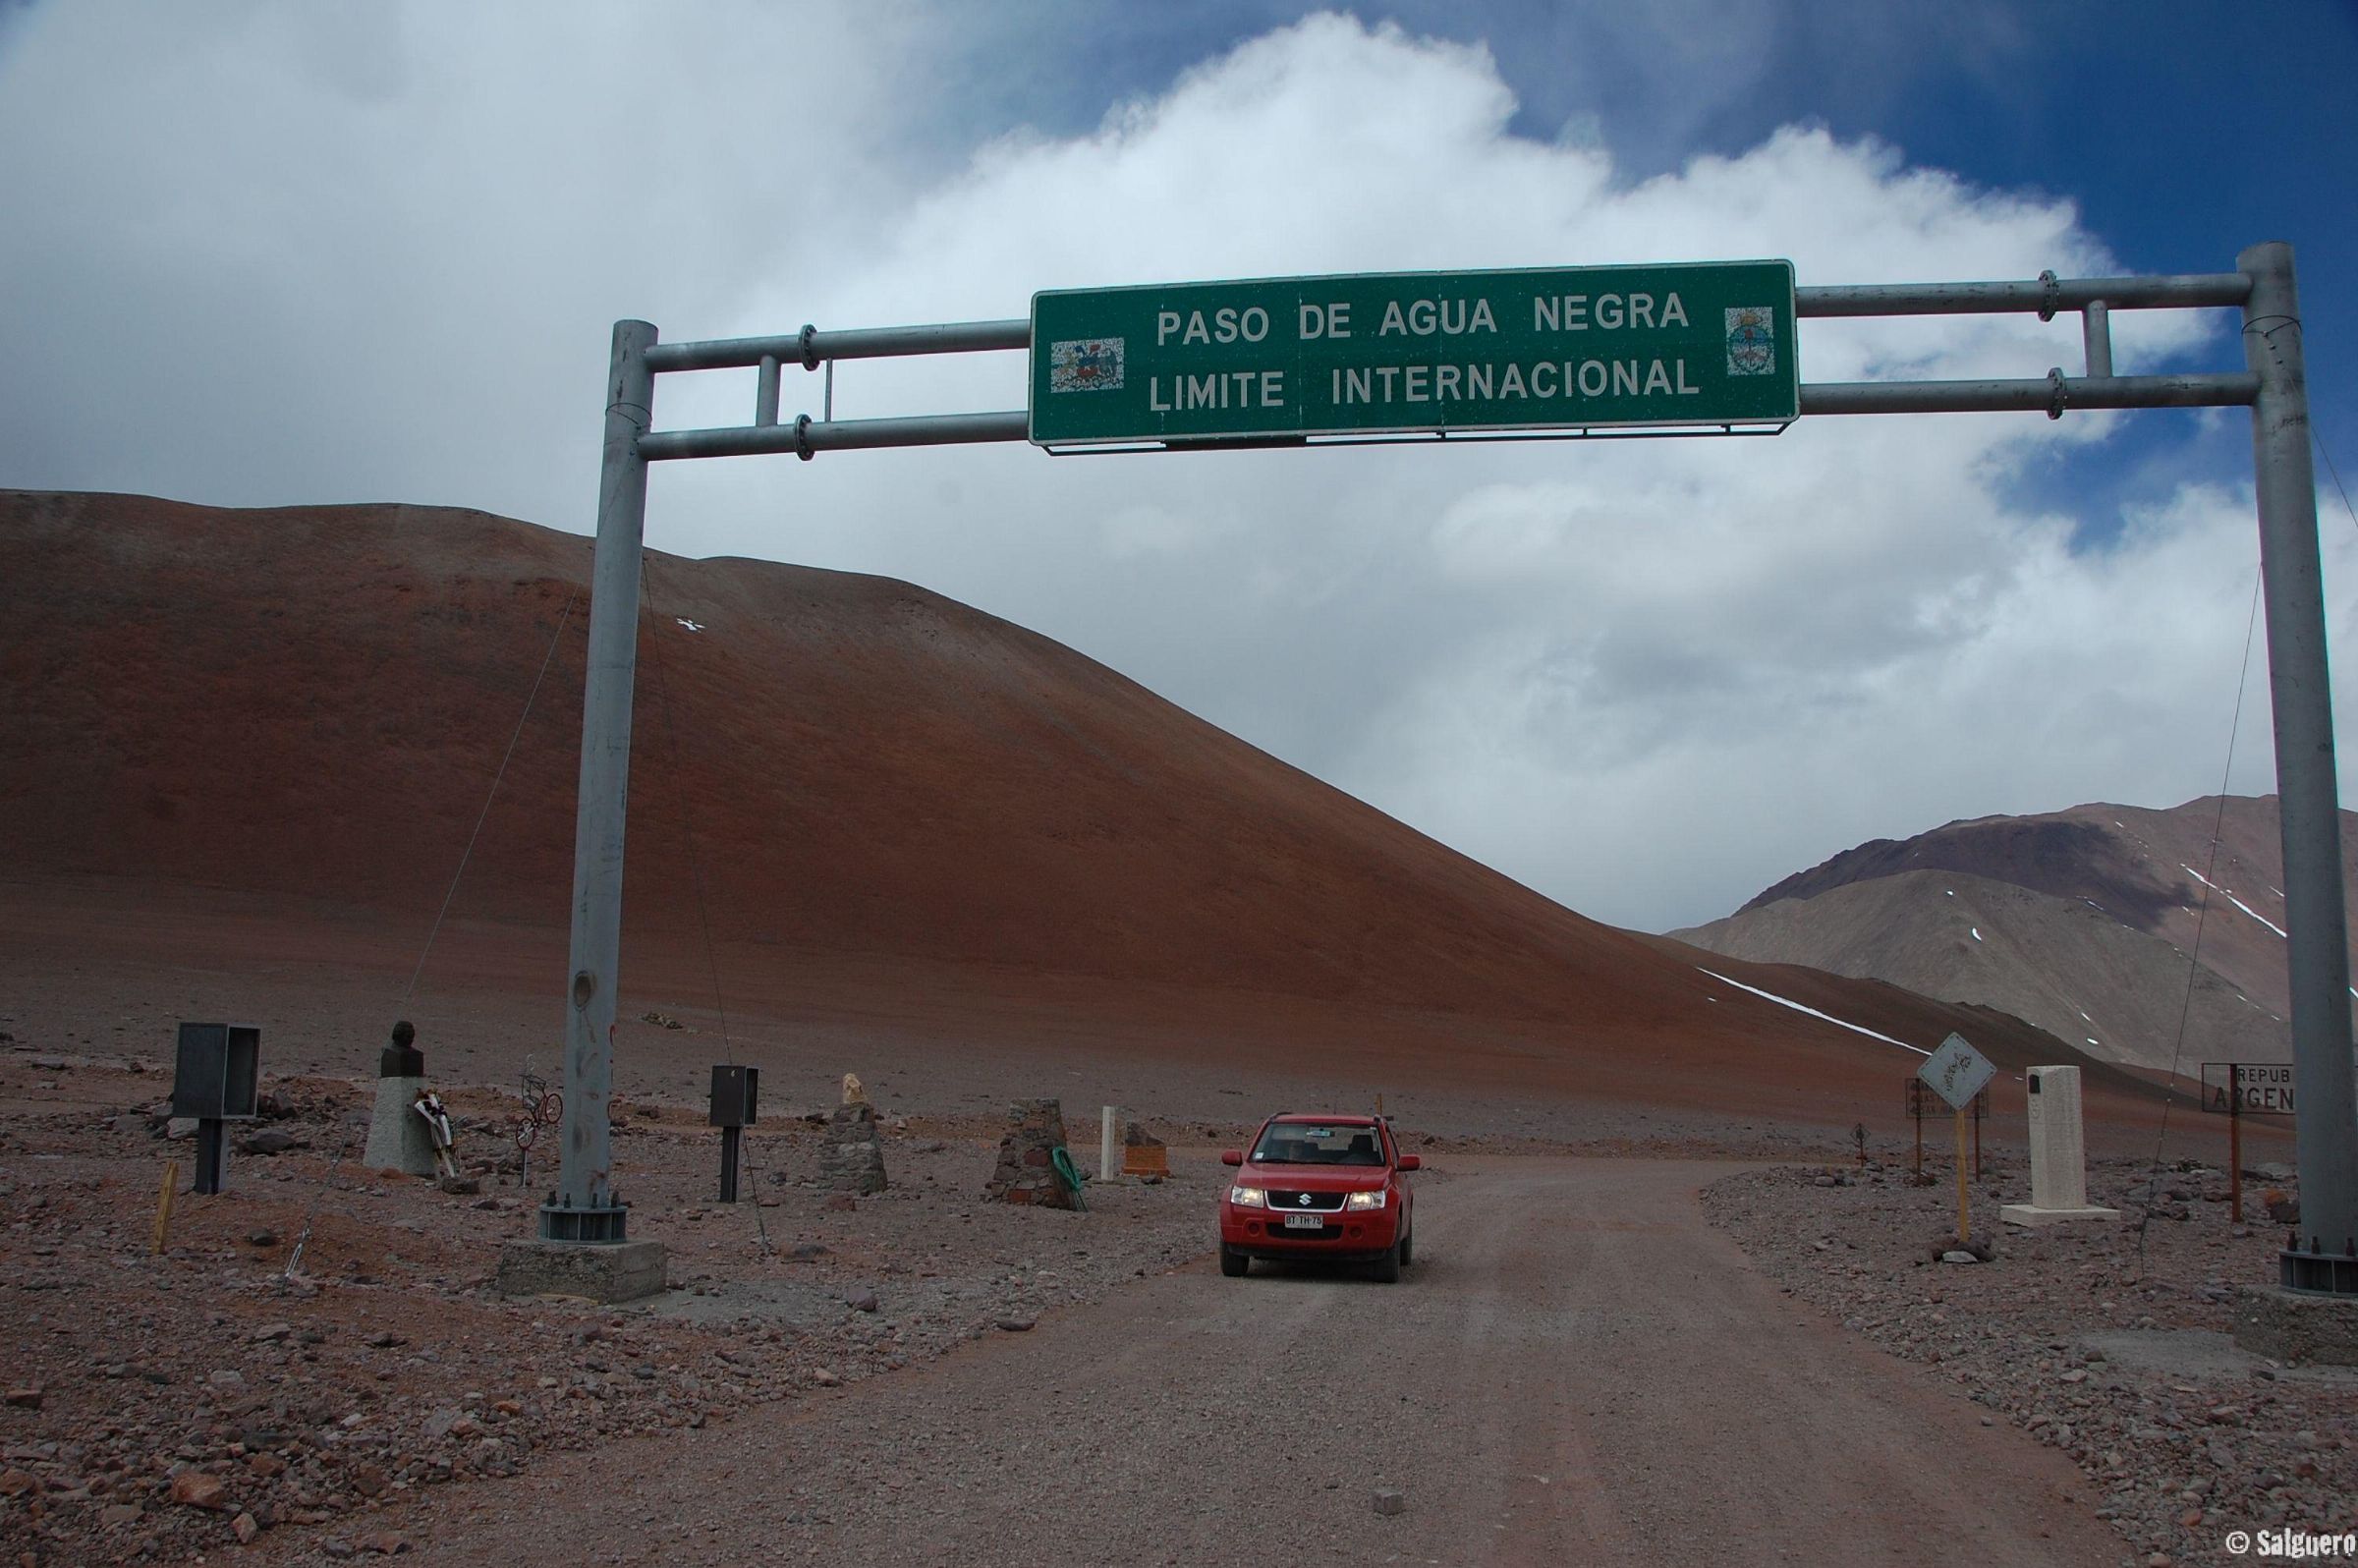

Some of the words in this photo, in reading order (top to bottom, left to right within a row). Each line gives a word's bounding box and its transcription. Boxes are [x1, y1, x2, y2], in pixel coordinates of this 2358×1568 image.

[1157, 307, 1269, 346] PASO
[1299, 303, 1352, 340] DE
[1378, 298, 1498, 337] AGUA
[1533, 292, 1690, 332] NEGRA
[1150, 370, 1284, 412] LIMITE
[1331, 358, 1701, 405] INTERNACIONAL
[2237, 1068, 2291, 1083] REPUB
[2214, 1086, 2294, 1110] ARGEN
